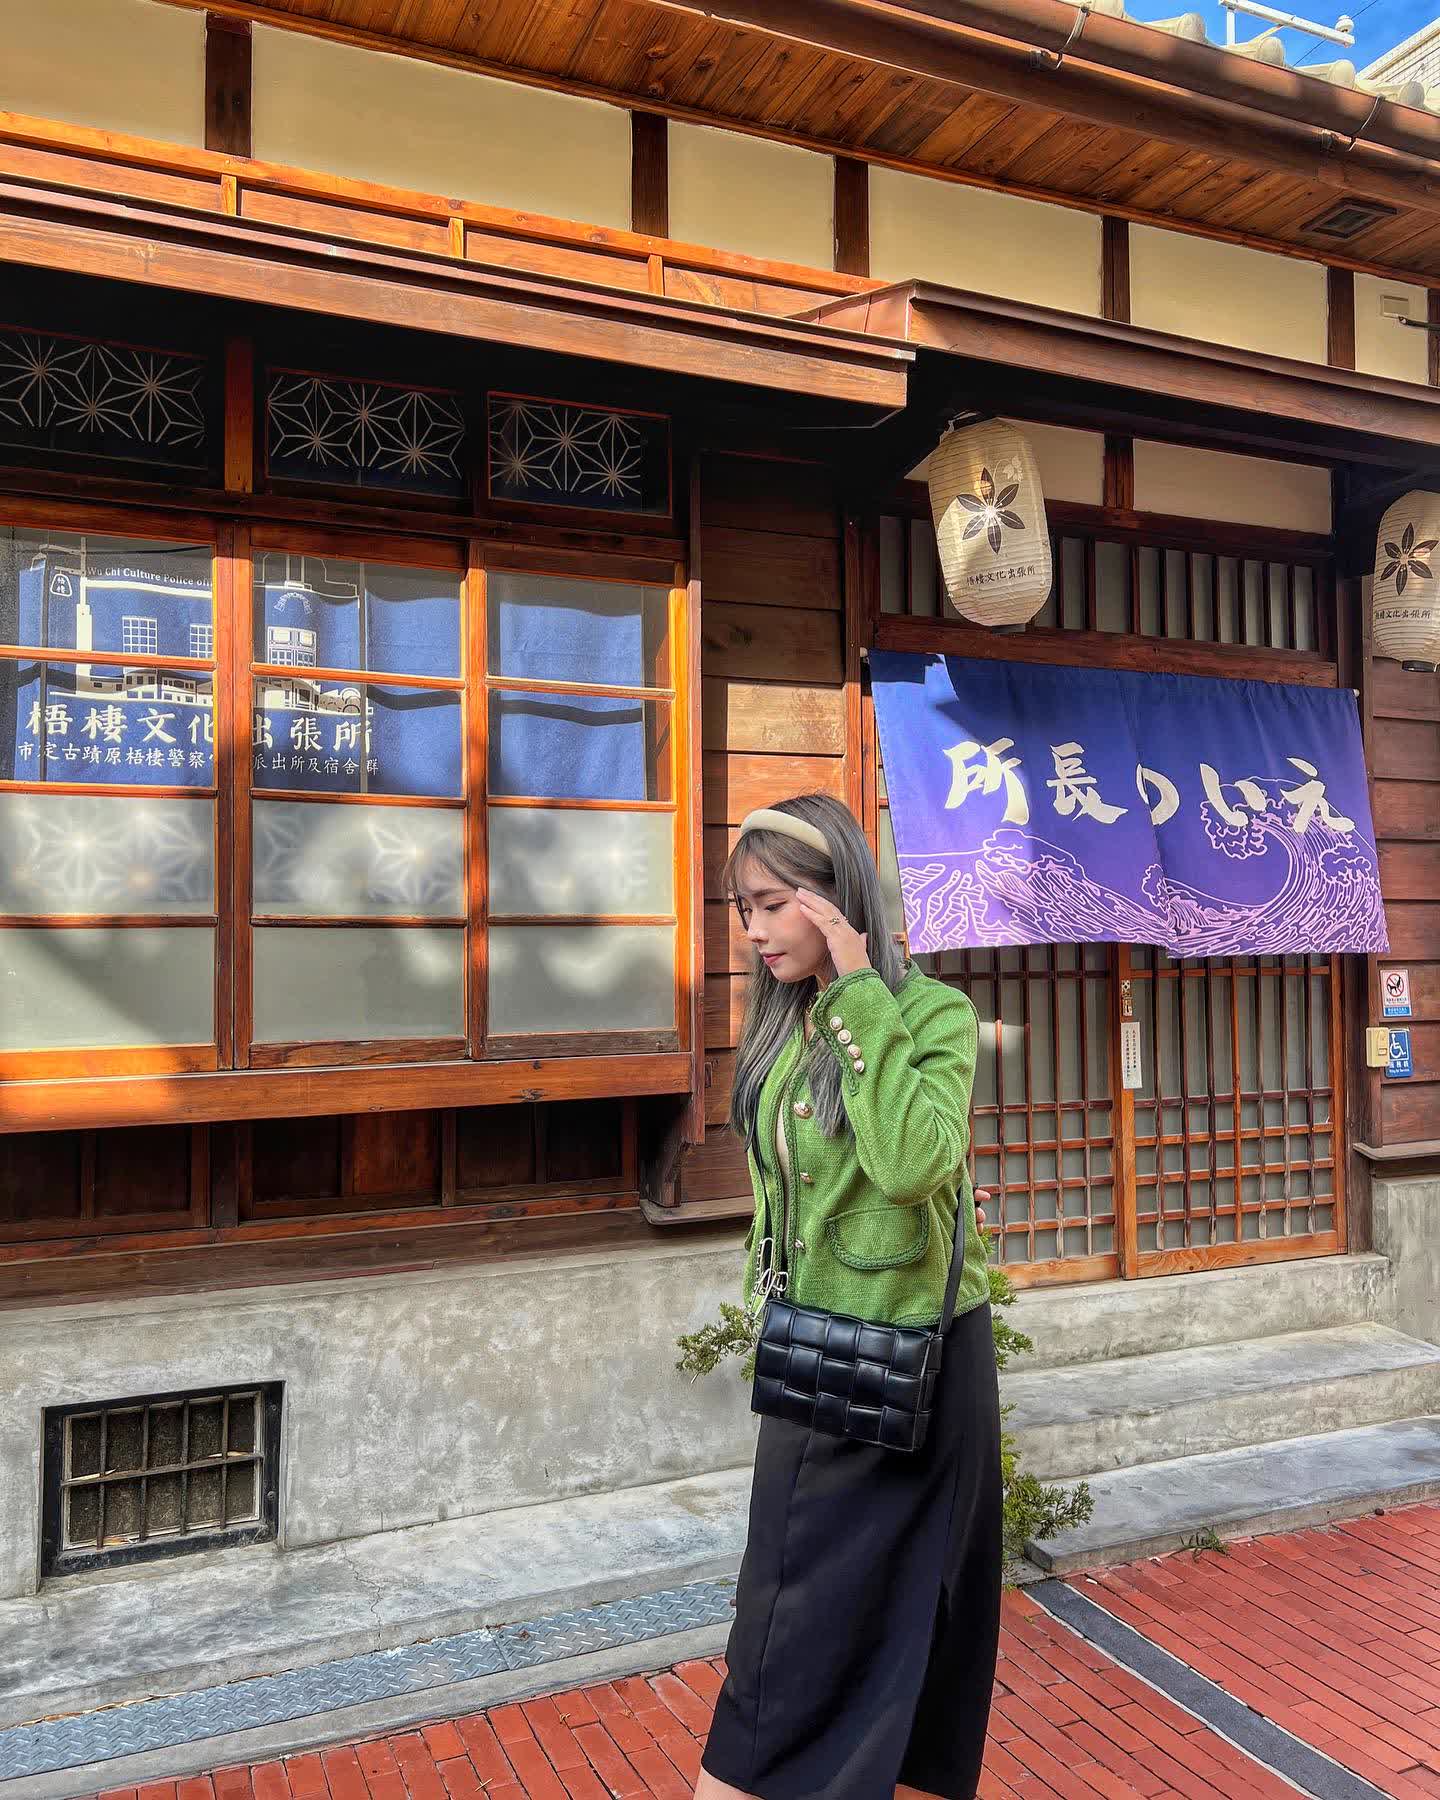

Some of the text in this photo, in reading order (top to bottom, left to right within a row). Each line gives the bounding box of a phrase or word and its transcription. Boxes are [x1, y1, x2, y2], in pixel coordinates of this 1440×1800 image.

[87, 566, 102, 576] Wu
[105, 567, 120, 577] Chi
[123, 567, 161, 581] Culture
[163, 574, 194, 586] Police
[1375, 608, 1432, 620] 文化出張所
